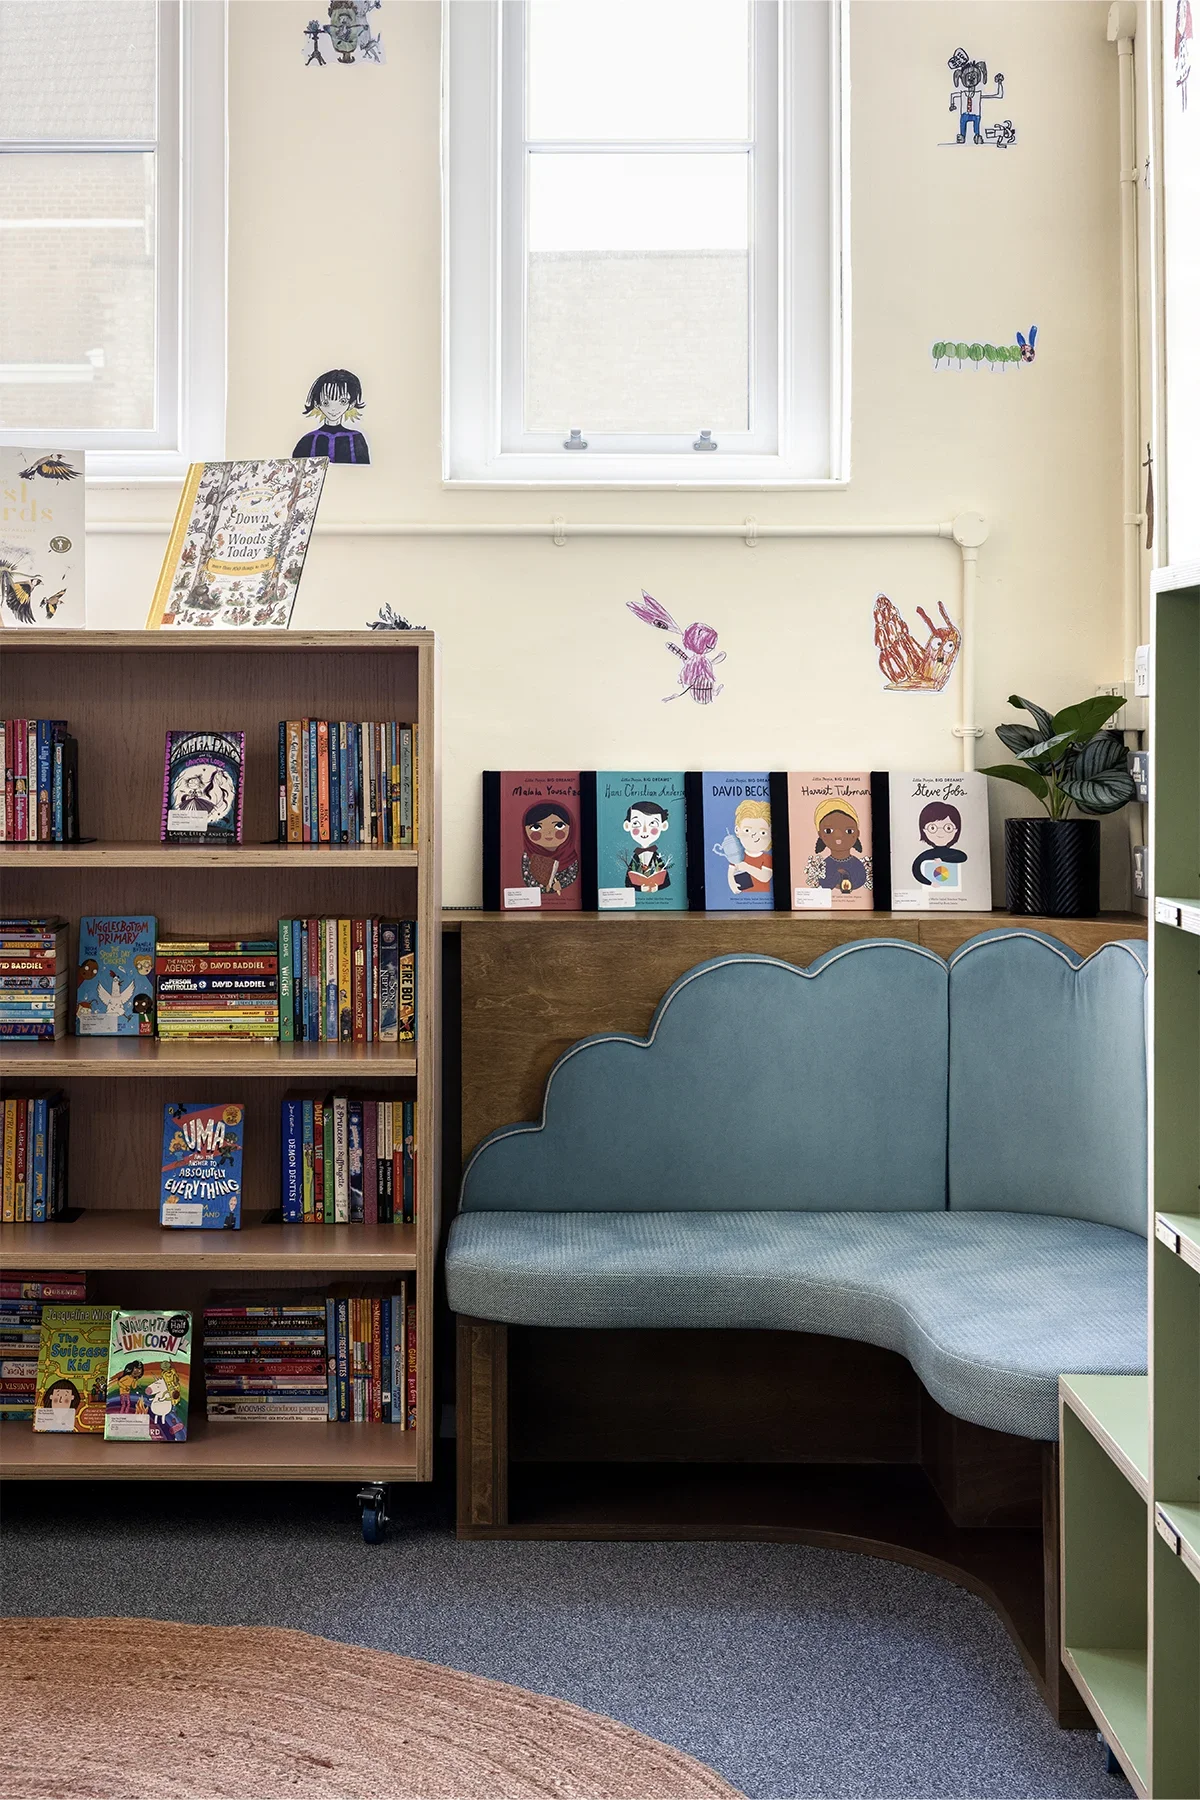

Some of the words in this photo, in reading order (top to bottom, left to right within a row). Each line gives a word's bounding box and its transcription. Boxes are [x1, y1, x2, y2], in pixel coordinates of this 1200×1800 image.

[235, 513, 270, 524] Down
[228, 533, 267, 545] Woods
[227, 546, 262, 559] Today
[39, 745, 49, 760] Lily
[40, 760, 48, 782] Alone
[512, 786, 543, 796] Malala
[605, 784, 622, 798] Hans
[624, 783, 657, 797] Christian
[712, 785, 743, 797] DAVID
[745, 785, 770, 797] BECK
[801, 784, 833, 796] Harriet
[834, 784, 872, 797] Tubman
[911, 783, 941, 798] Steve
[942, 783, 968, 801] Jobs
[86, 919, 149, 937] WIGGLESBOTTOM
[97, 932, 141, 949] PRIMARY
[11, 962, 43, 970] BADDIEL
[103, 957, 128, 965] CHICKEN
[164, 964, 197, 972] AGENCY
[233, 961, 265, 969] BADDIEL
[281, 966, 290, 997] WITCHES
[401, 963, 413, 984] FIRE
[160, 983, 198, 991] CONTROLLER
[380, 969, 389, 1009] NEPTUNE
[389, 981, 397, 1001] SON
[401, 986, 413, 1008] BOY
[16, 1024, 30, 1034] ME
[31, 1024, 47, 1034] FLY
[6, 1110, 15, 1131] GIRL
[315, 1104, 323, 1127] DAISY
[182, 1118, 226, 1152] UMA
[336, 1111, 344, 1144] Princess
[17, 1147, 25, 1168] Project
[288, 1138, 296, 1168] DEMON
[315, 1144, 323, 1160] LIFE
[6, 1155, 15, 1180] STARS
[179, 1167, 226, 1180] ABSOLUTELY
[335, 1151, 344, 1188] Suffragette
[164, 1179, 240, 1201] EVERYTHING
[288, 1169, 296, 1202] DENTIST
[43, 1287, 78, 1296] QUEENIE
[46, 1309, 89, 1325] Jacqueline
[373, 1309, 381, 1334] MIRACLE
[170, 1322, 187, 1330] Half
[58, 1333, 79, 1344] The
[122, 1332, 178, 1352] UNICORN
[51, 1343, 108, 1357] Suitcase
[67, 1359, 91, 1372] Kid
[409, 1348, 417, 1373] GIANTS
[237, 1405, 266, 1413] SHADOW
[267, 1403, 298, 1412] morpurgo
